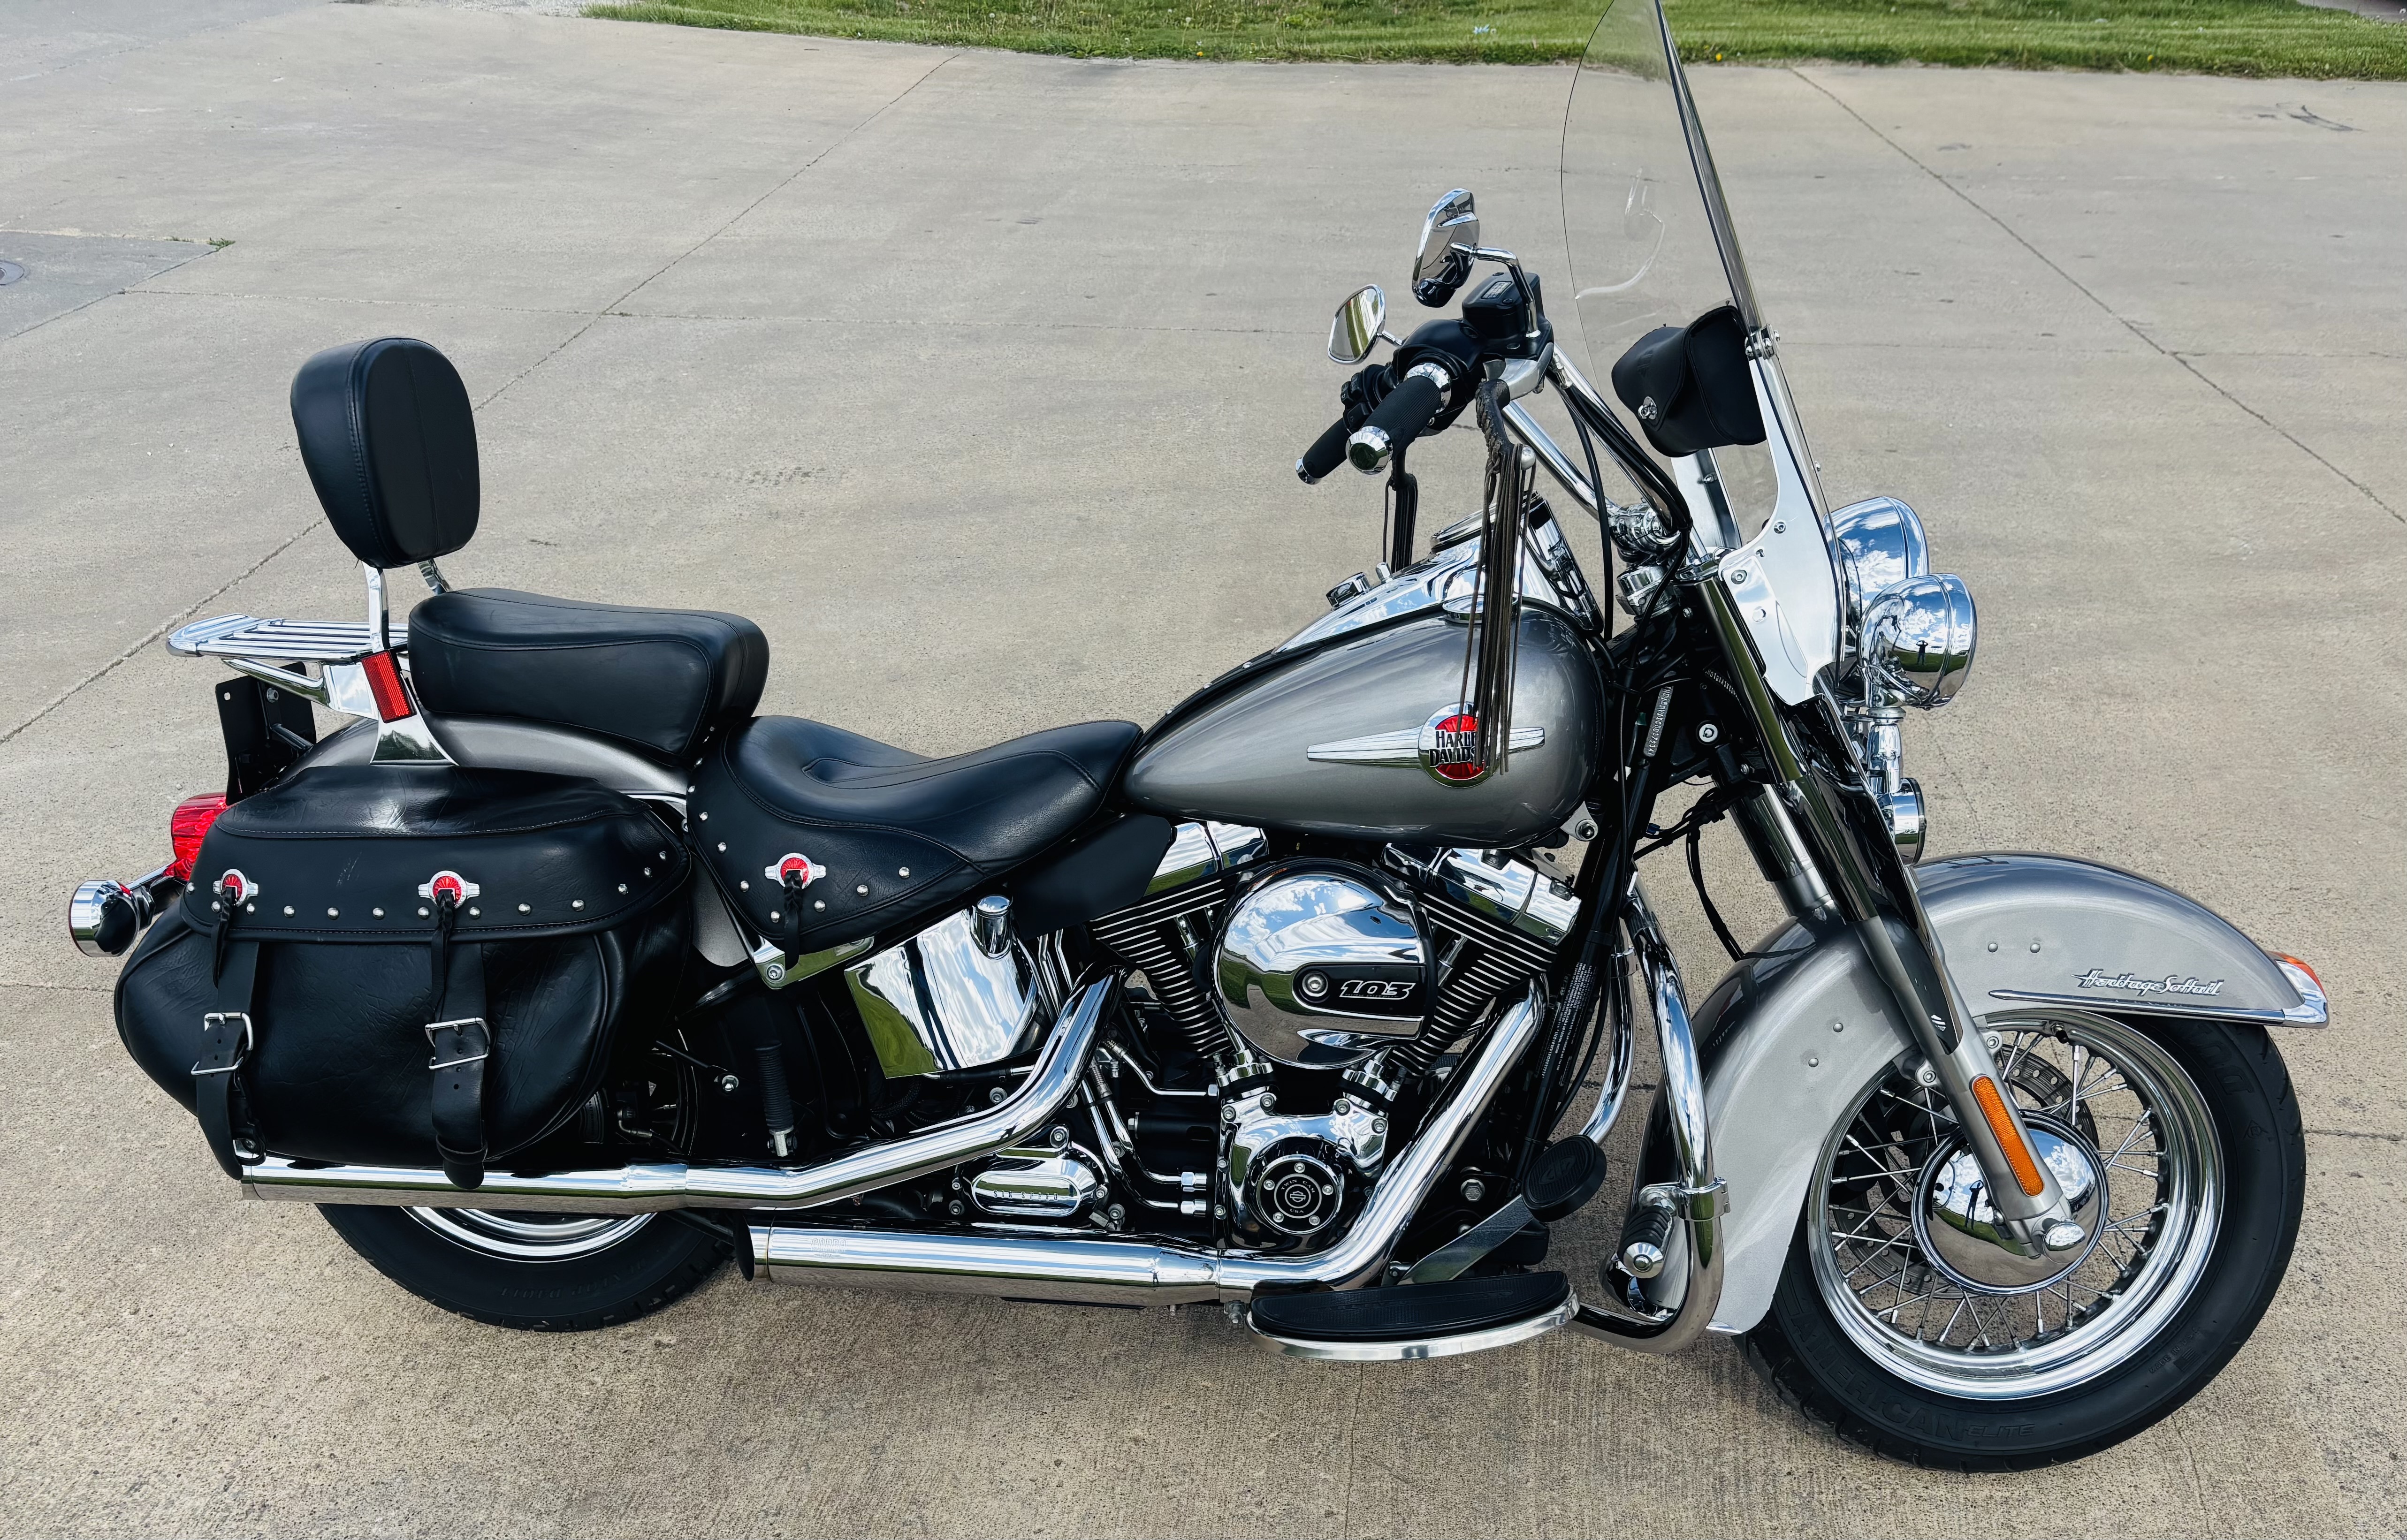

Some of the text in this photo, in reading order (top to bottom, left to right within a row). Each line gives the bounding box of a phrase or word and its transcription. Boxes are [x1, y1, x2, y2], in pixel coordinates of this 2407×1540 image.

[2071, 968, 2224, 996] Heritage Softail
[1339, 980, 1416, 1000] 103
[1281, 1179, 1297, 1190] TWIN
[993, 1190, 1059, 1201] SIX SPEED
[1966, 1423, 2035, 1438] ELITE
